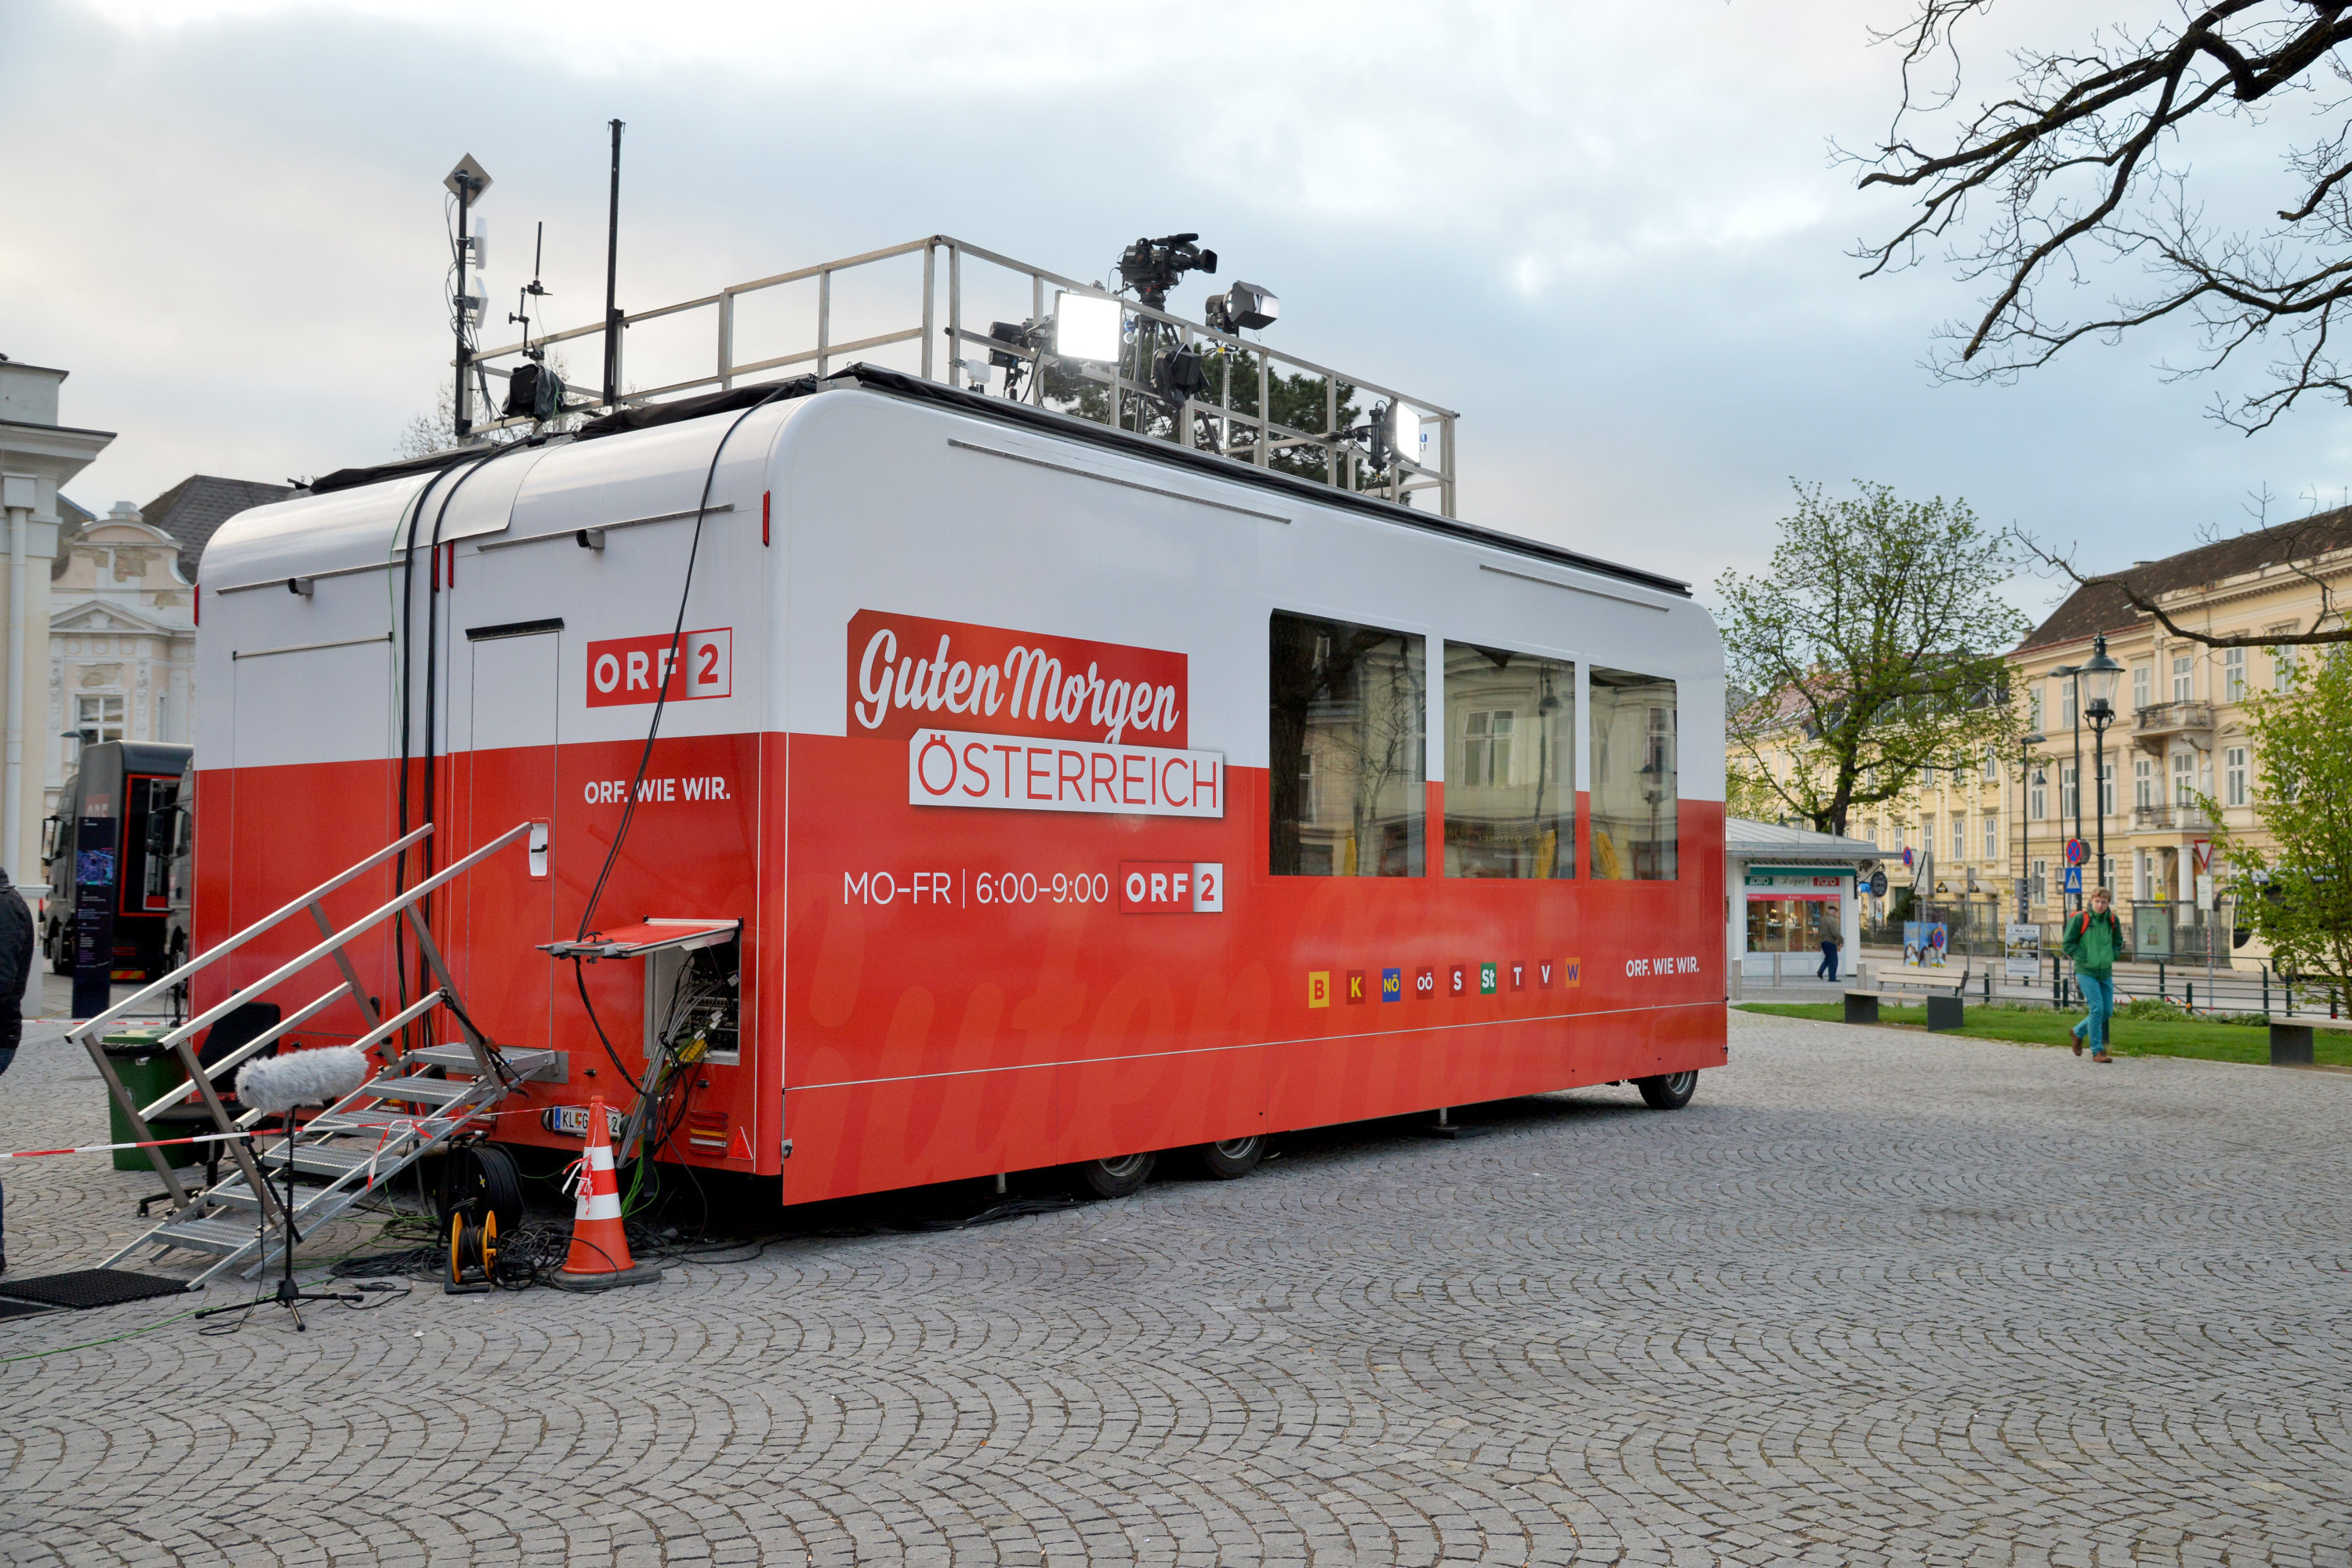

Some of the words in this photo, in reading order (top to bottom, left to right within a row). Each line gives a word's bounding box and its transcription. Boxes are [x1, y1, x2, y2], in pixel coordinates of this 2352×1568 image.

[593, 647, 680, 693] ORF
[698, 643, 719, 684] 2
[855, 629, 1004, 729] Guten
[1004, 645, 1179, 745] Morgen
[917, 733, 1217, 808] ÖSTERREICH
[584, 779, 629, 804] ORF.
[636, 778, 675, 802] WIE
[682, 776, 731, 800] WIR.
[844, 871, 952, 905] MO-FR
[975, 872, 1109, 904] 6:00-9:00
[1125, 873, 1189, 902] ORF
[1200, 873, 1214, 902] 2
[1749, 877, 1769, 885] LOTTO
[1817, 877, 1836, 886] TOTO
[1513, 967, 1522, 985] T
[1541, 965, 1551, 984] V
[1566, 964, 1579, 981] W
[1626, 960, 1650, 977] ORF.
[1653, 957, 1674, 975] WIE
[1676, 956, 1700, 973] WIR.
[1351, 977, 1362, 997] K
[1383, 975, 1399, 992] NÖ
[1417, 972, 1433, 990] OÖ
[1454, 971, 1462, 990] S
[1482, 969, 1495, 988] St
[1314, 979, 1324, 1000] B
[562, 1111, 574, 1128] KL
